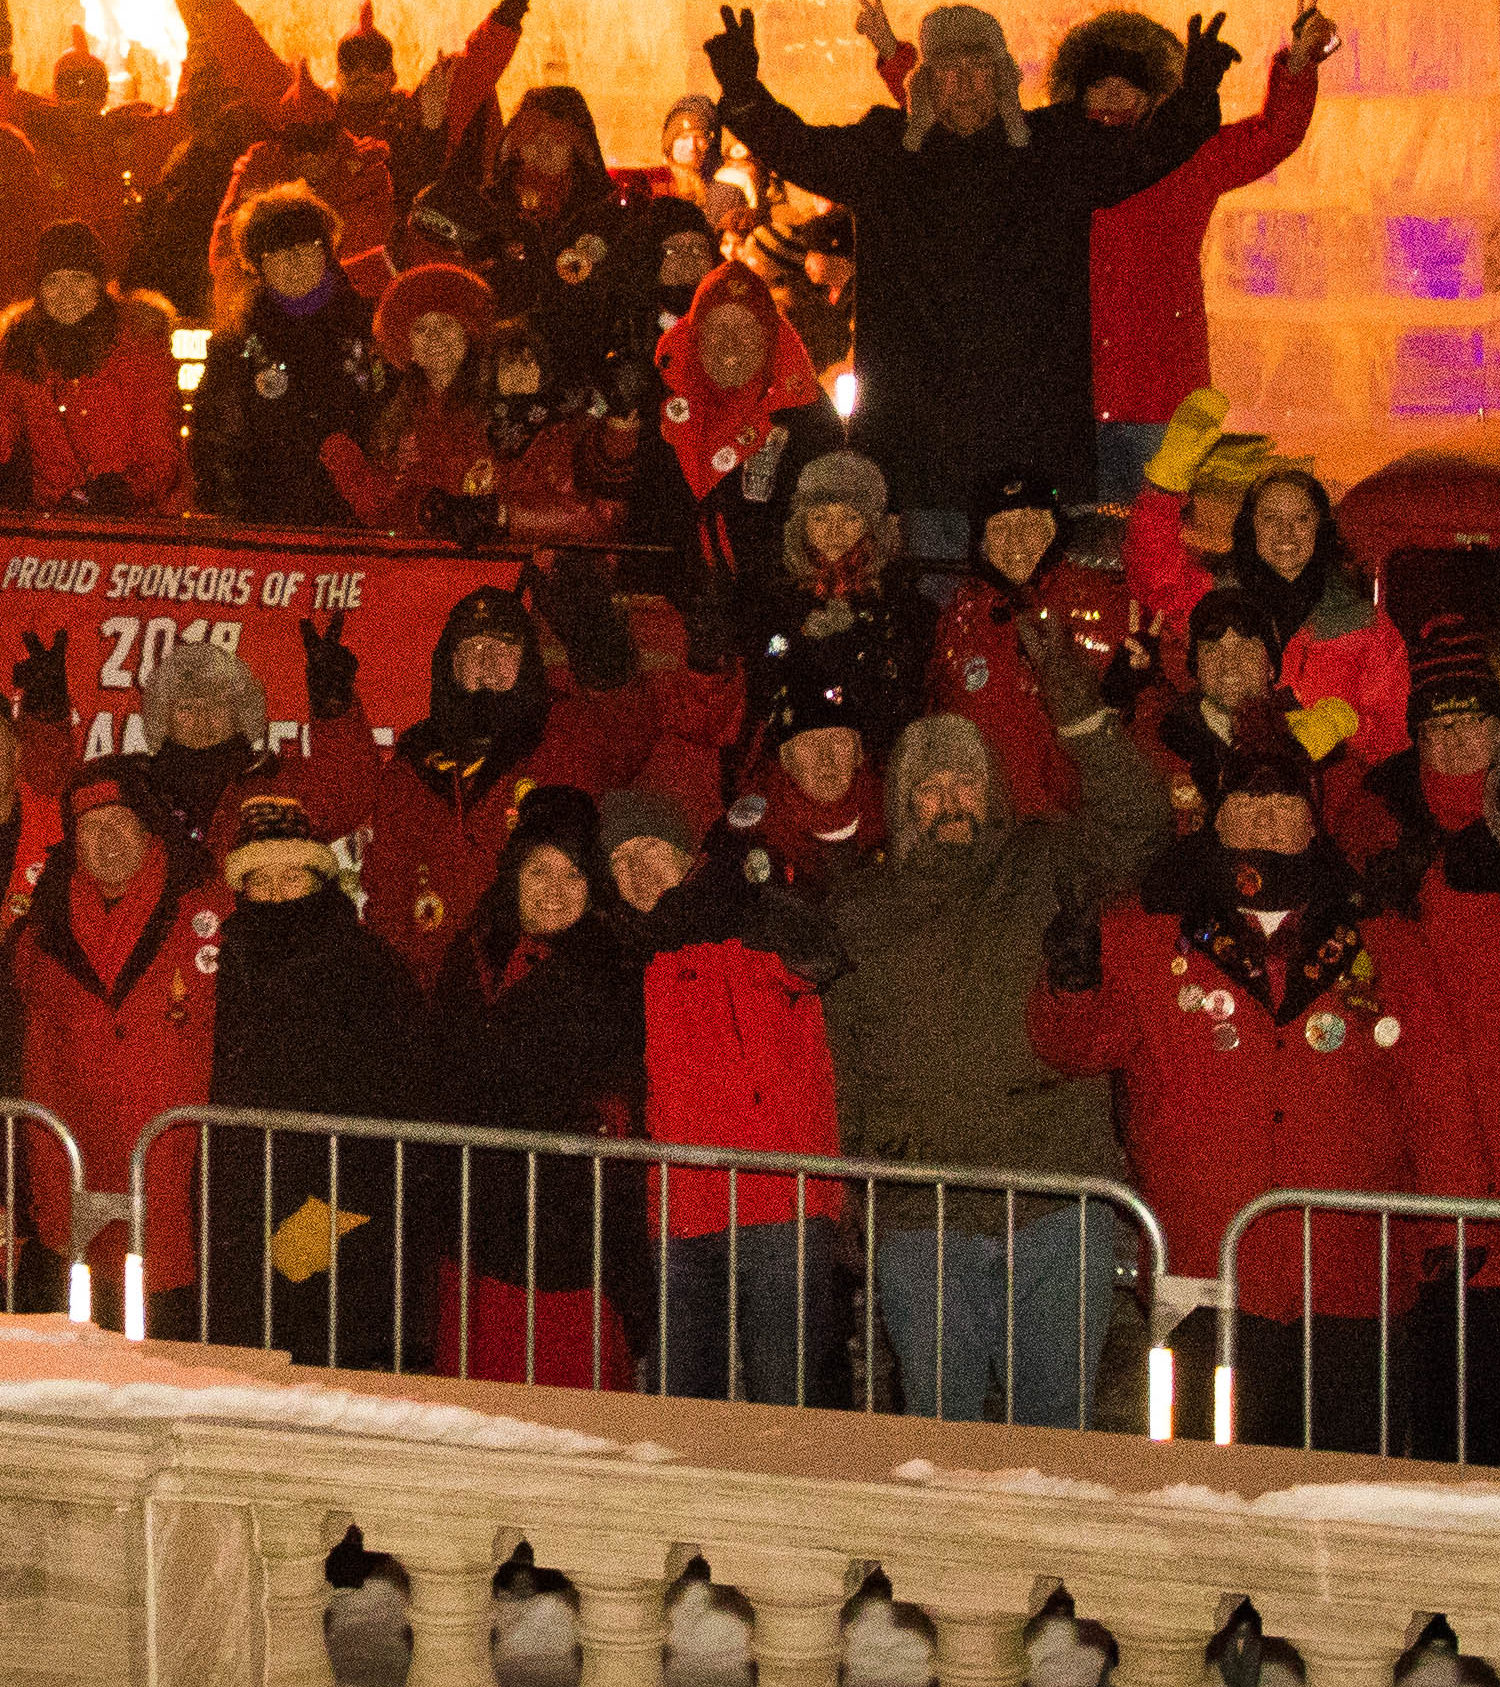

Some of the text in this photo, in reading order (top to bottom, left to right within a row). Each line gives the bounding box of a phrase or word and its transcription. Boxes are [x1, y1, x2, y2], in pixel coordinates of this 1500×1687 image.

[2, 556, 366, 610] PROUD SPONSORS OF THE
